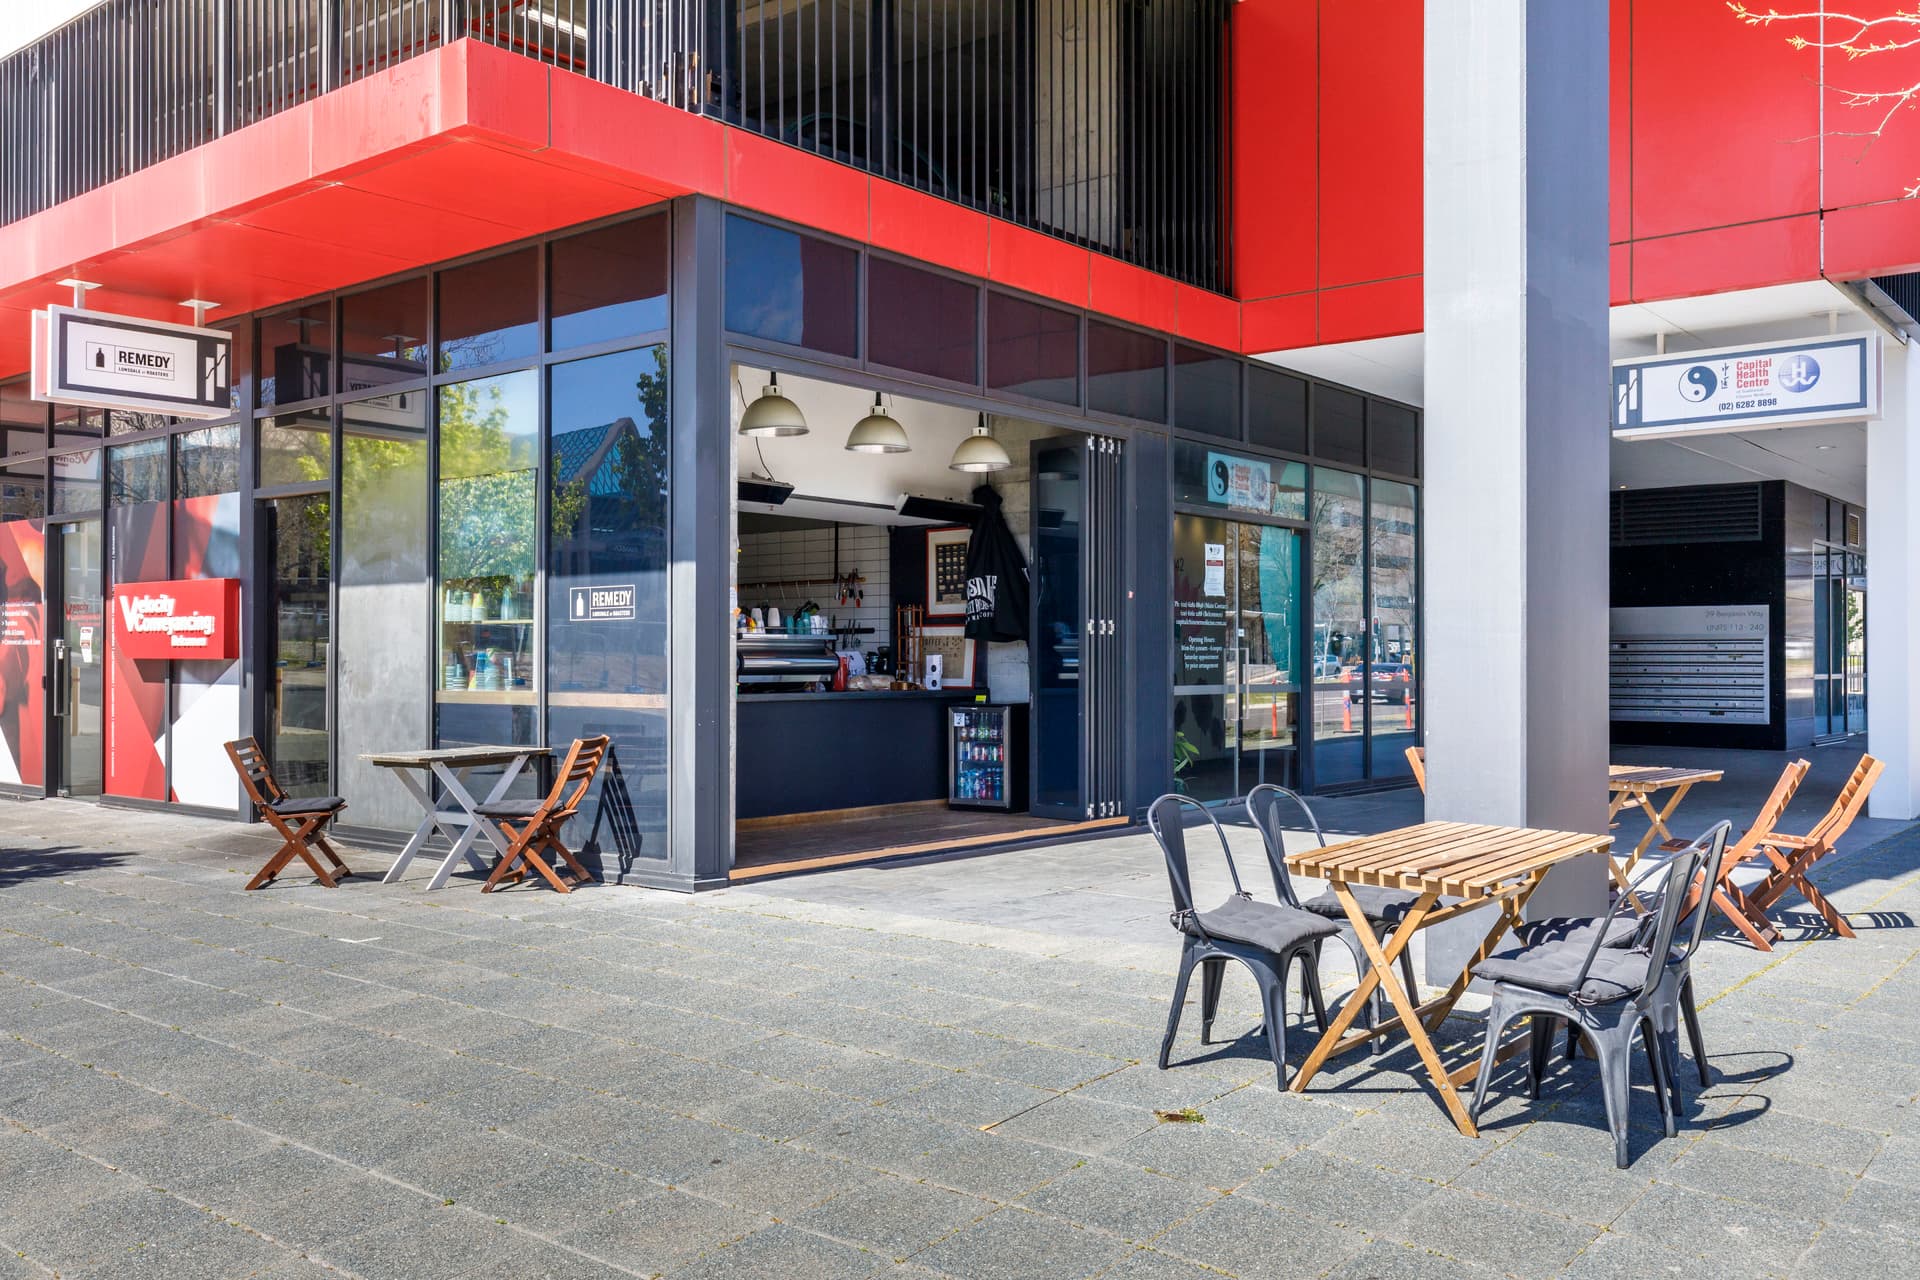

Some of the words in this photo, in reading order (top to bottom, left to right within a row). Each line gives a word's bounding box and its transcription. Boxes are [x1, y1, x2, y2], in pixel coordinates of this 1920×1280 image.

[118, 350, 170, 369] REMEDY
[1736, 358, 1772, 371] Capital
[118, 367, 141, 375] LONSDALE
[146, 370, 169, 378] ROASTERS
[1736, 367, 1769, 379] Health
[1736, 378, 1770, 389] Centre
[1718, 402, 1734, 412] (02)
[1735, 400, 1755, 409] 6282
[592, 590, 632, 607] REMEDY
[119, 593, 176, 632] Velocity
[1747, 610, 1764, 618] Way
[135, 609, 216, 637] Conveyancing
[1749, 623, 1765, 632] 240
